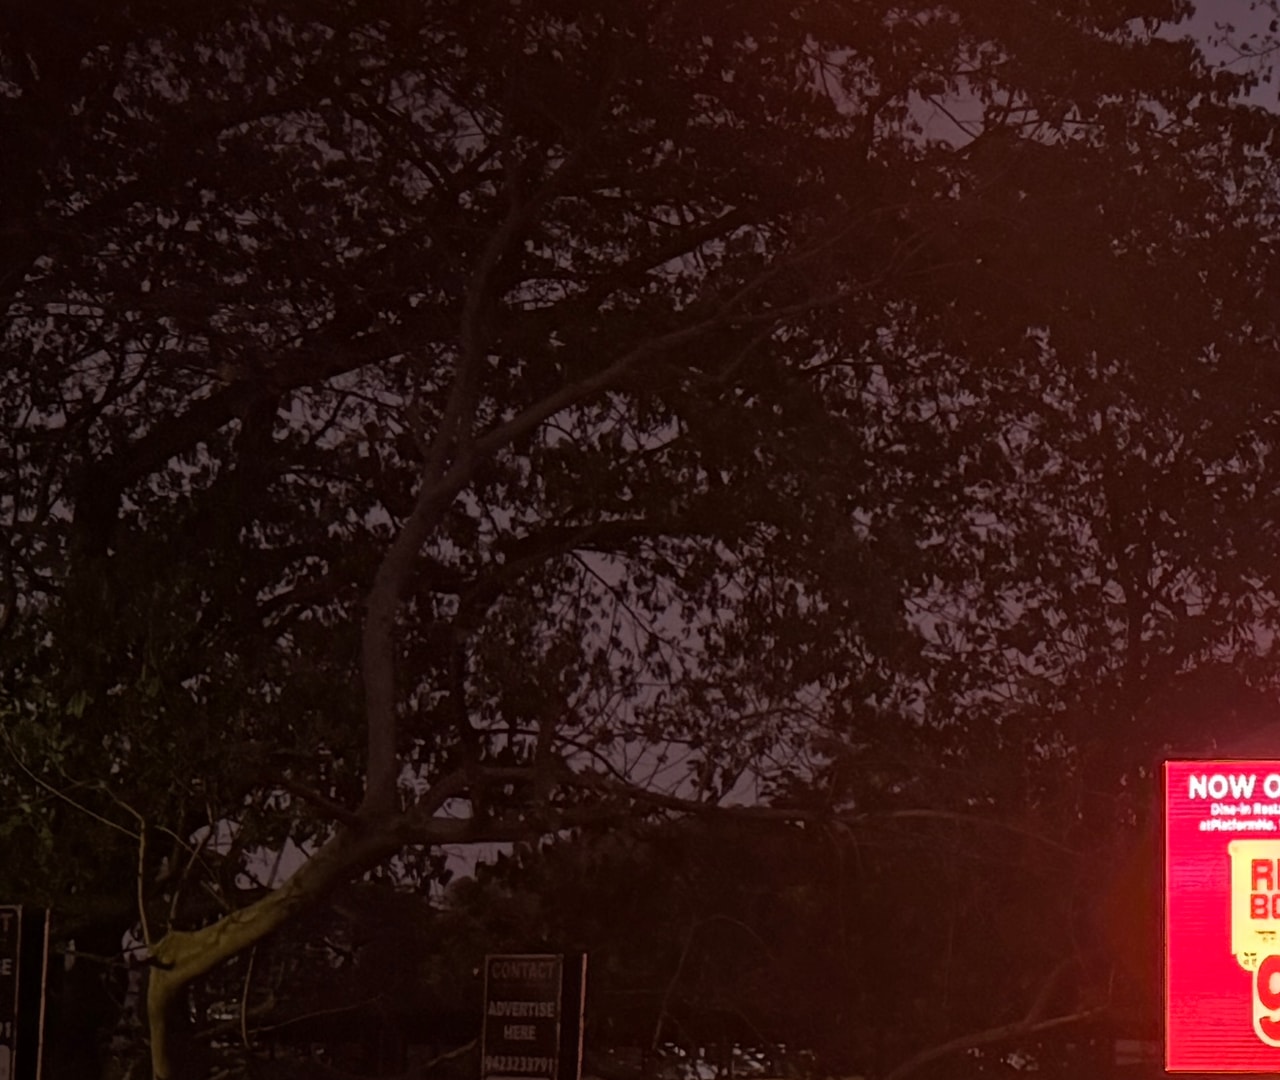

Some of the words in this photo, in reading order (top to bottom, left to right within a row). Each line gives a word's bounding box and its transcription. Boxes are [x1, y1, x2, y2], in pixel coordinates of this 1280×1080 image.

[1188, 774, 1256, 799] NOW
[491, 961, 554, 979] CONTACT
[487, 1000, 555, 1018] ADVERTISE
[503, 1024, 537, 1040] HERE
